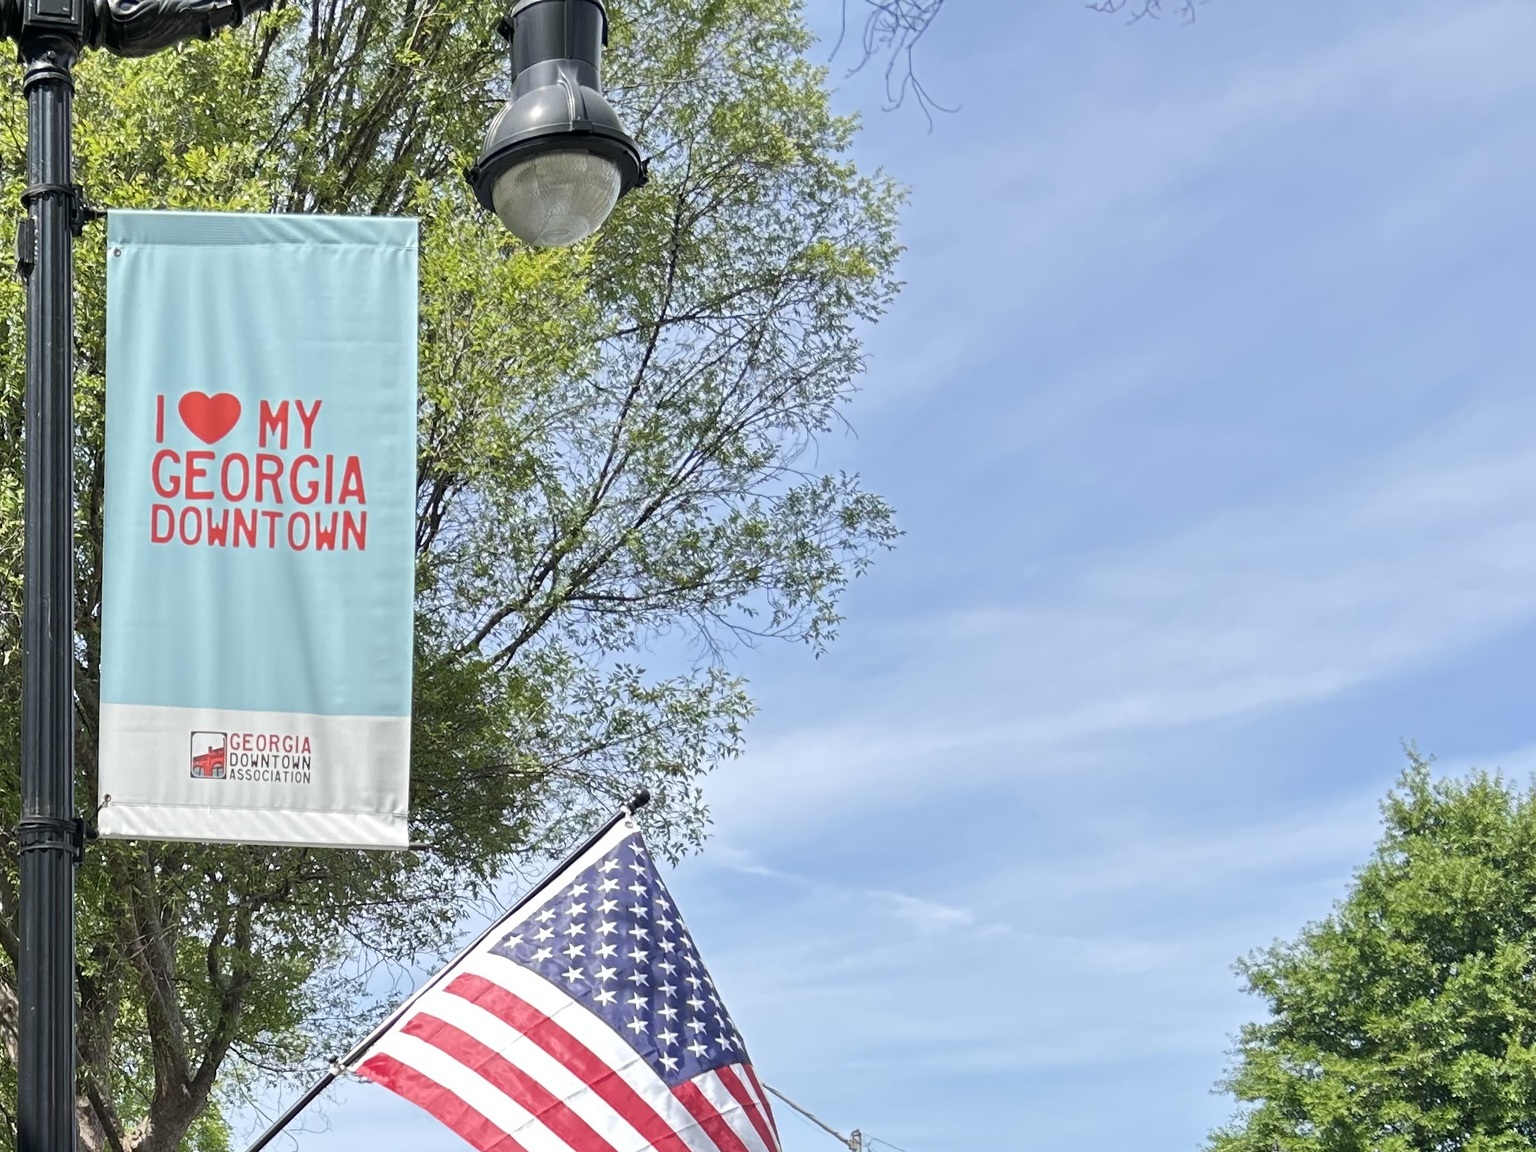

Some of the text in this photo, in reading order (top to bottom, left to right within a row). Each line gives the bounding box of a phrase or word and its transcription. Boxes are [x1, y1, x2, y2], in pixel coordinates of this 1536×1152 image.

[156, 394, 322, 449] I MY
[151, 449, 366, 505] GEORGIA
[151, 503, 367, 551] DOWNTOWN
[229, 733, 311, 754] GEORGIA
[229, 752, 311, 771] DOWNTOWN
[229, 768, 311, 784] ASSOCIATION
